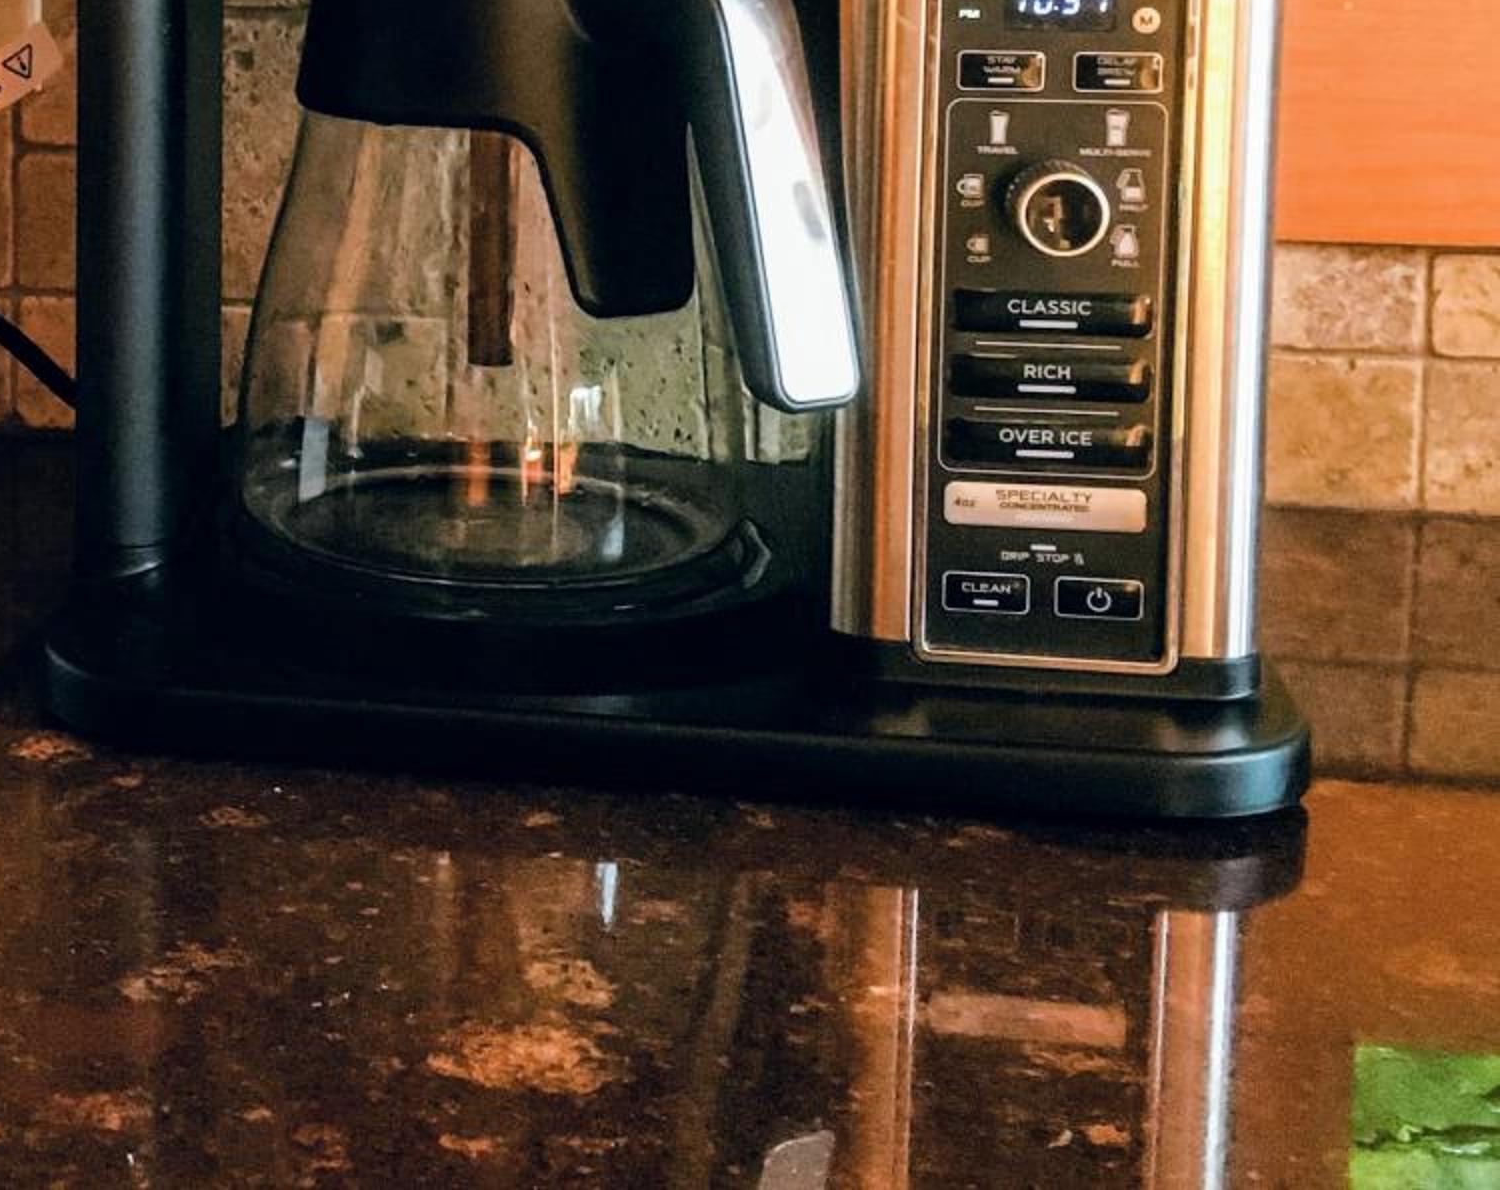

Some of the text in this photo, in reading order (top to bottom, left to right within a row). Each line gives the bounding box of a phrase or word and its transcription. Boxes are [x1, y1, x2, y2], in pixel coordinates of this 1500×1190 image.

[959, 9, 981, 19] PM
[977, 145, 1019, 155] TRAVEL
[1007, 299, 1092, 316] CLASSIC
[1023, 364, 1071, 380] RICH
[999, 428, 1093, 446] OVER ICE
[995, 489, 1093, 504] SPECIALTY
[1001, 551, 1070, 563] DRIP STOP
[961, 581, 1012, 594] CLEAN
